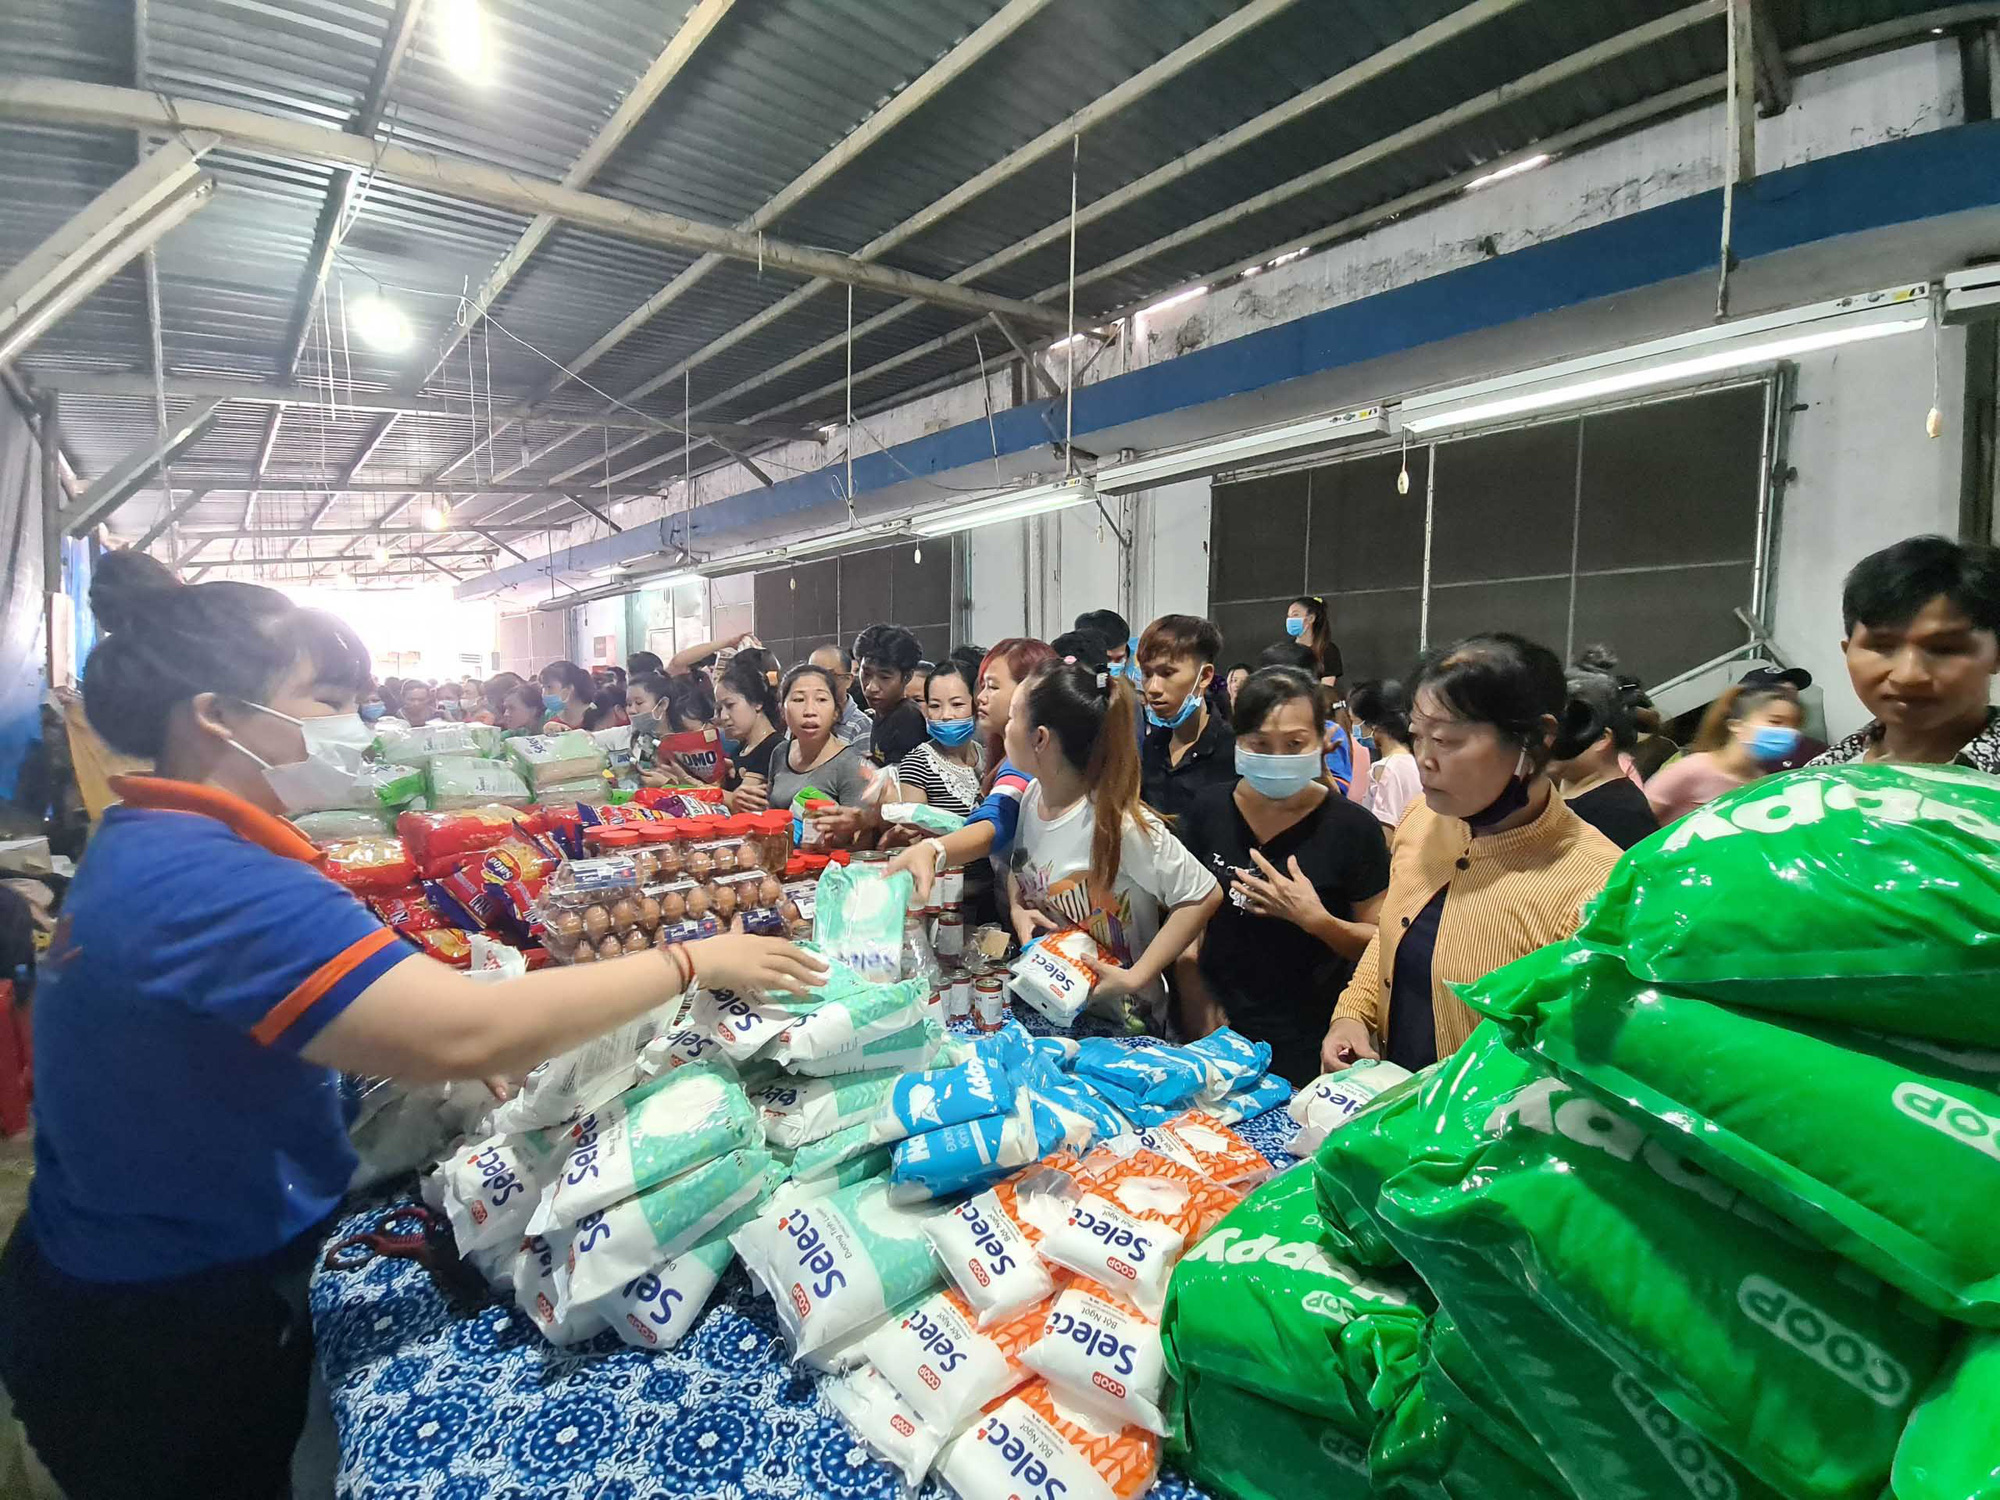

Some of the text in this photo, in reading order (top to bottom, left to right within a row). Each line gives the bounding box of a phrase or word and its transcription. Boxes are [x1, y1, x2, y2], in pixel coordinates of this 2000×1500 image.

[682, 750, 717, 767] OMO
[1032, 953, 1075, 992] Select
[468, 1146, 524, 1206] Select
[954, 1199, 1016, 1276] Select
[1068, 1207, 1153, 1264] Select
[778, 1208, 846, 1298] Select
[1108, 1257, 1136, 1280] COOP
[969, 1259, 990, 1287] COOP
[623, 1273, 682, 1324] Sel
[793, 1283, 811, 1315] COOP
[1080, 1306, 1102, 1322] Ngọt
[1101, 1316, 1119, 1330] Bột
[902, 1309, 968, 1376] Select
[1045, 1312, 1136, 1376] Select
[1746, 1289, 1904, 1396] COOP
[918, 1365, 941, 1390] COOP
[1093, 1372, 1125, 1397] COOP
[891, 1415, 914, 1436] COOP
[1017, 1421, 1041, 1444] Ngọt
[977, 1417, 1067, 1500] Select
[1035, 1440, 1055, 1459] Bột
